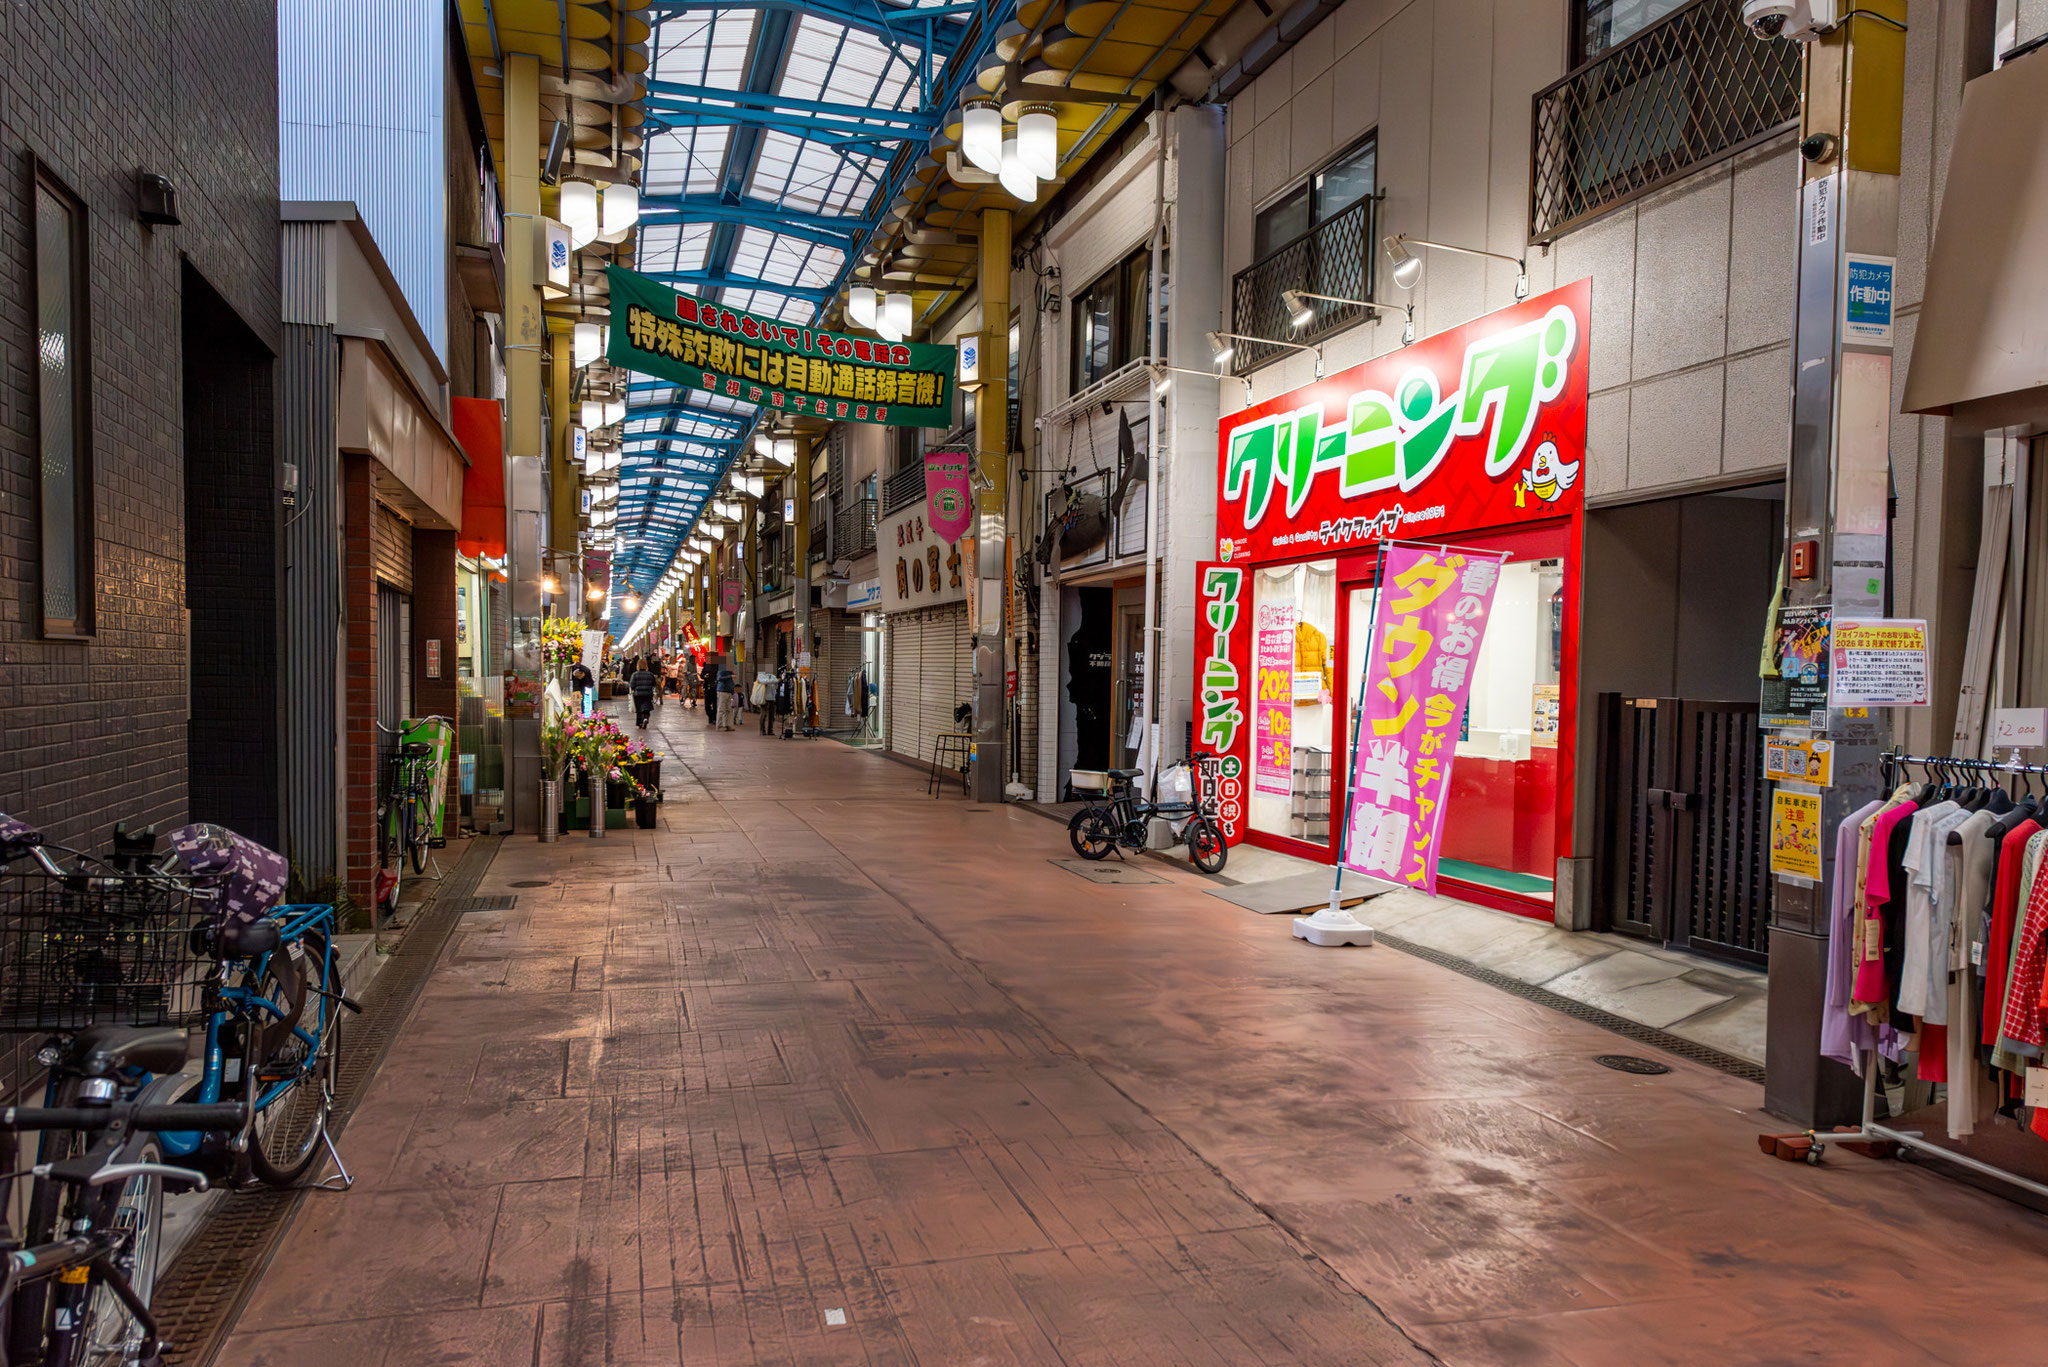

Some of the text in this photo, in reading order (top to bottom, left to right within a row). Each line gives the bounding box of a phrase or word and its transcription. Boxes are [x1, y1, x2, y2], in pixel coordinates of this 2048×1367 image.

[1817, 180, 1828, 240] 防犯カメラ作動中
[1850, 268, 1890, 283] 防犯カメラ
[1850, 285, 1890, 305] 作動中
[675, 295, 891, 364] 騙されないで！その電話
[629, 306, 944, 407] 特殊詐欺には自動通話録音機！
[703, 373, 888, 422] 警視庁南千住警察署
[1224, 304, 1577, 530] クリーニング
[1319, 504, 1403, 545] テイクファイブ
[1201, 567, 1244, 754] クリーニング
[1259, 667, 1290, 701] 20%
[1279, 690, 1291, 703] OFF
[1268, 708, 1291, 736] 10%
[1274, 741, 1290, 766] 5%
[1777, 796, 1817, 810] 自転車走行
[1785, 808, 1806, 822] 注意
